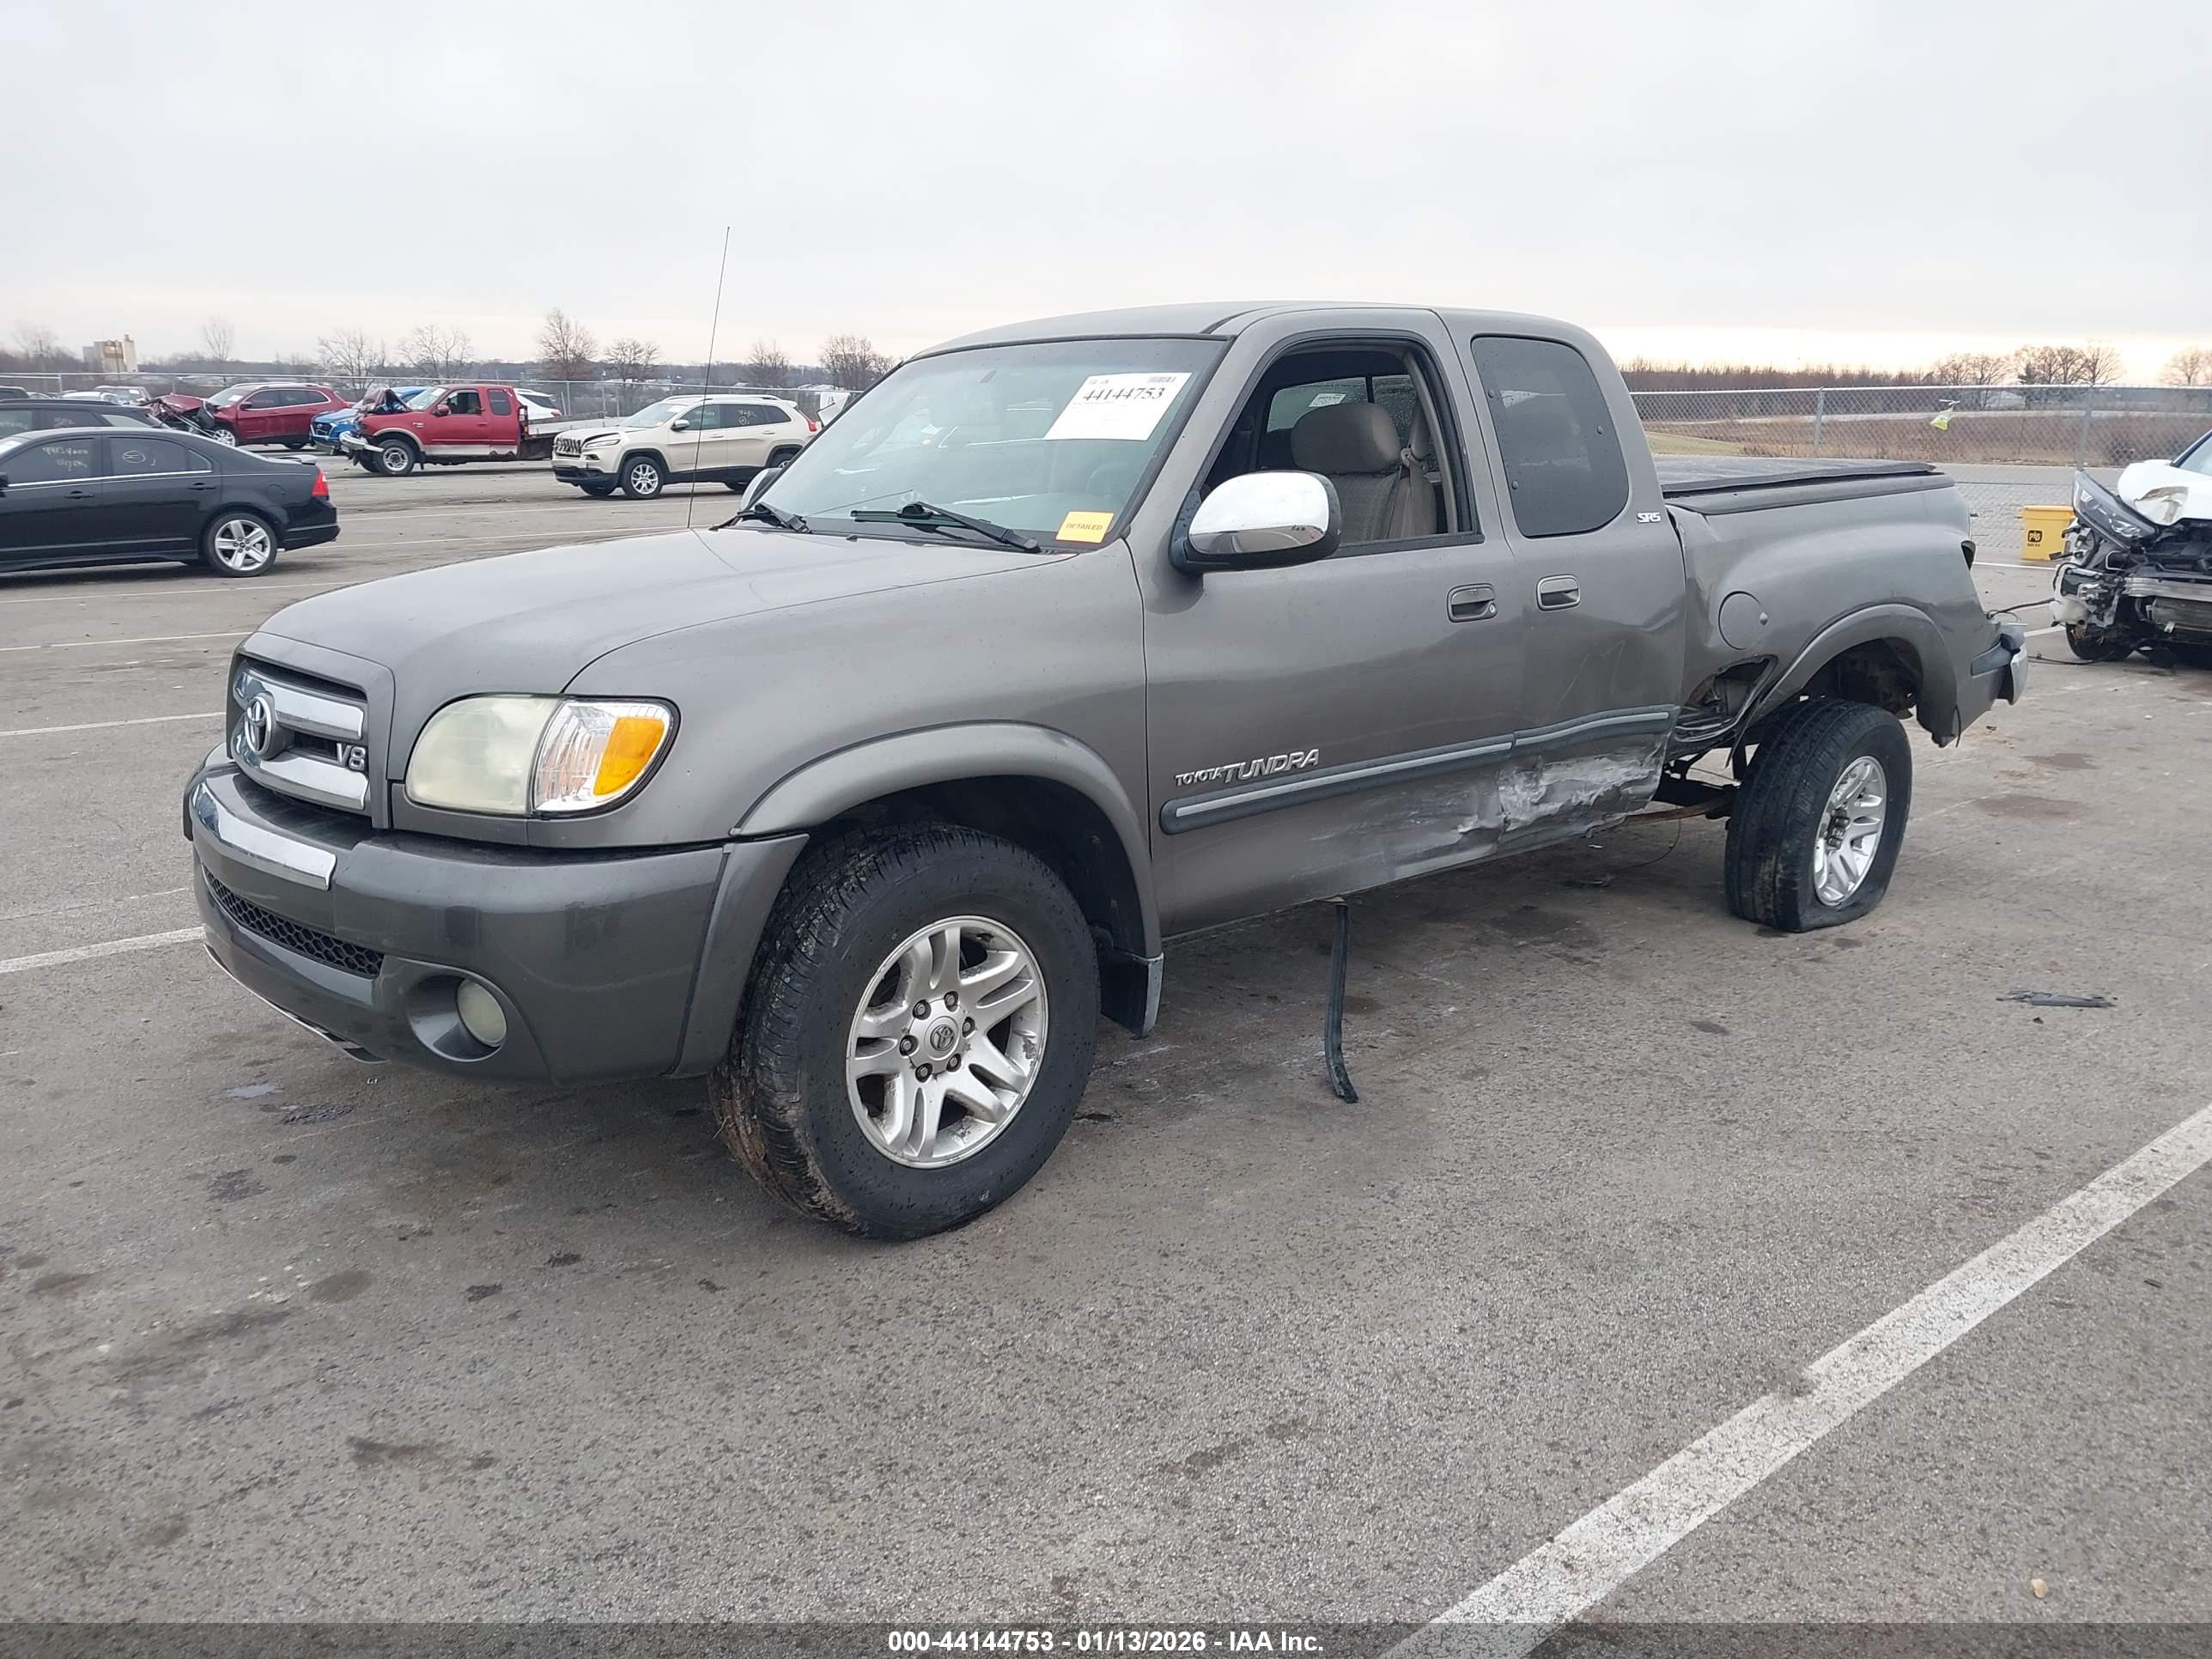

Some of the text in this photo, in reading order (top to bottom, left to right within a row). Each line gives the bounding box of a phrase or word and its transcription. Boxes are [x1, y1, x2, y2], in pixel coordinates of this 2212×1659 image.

[1083, 387, 1165, 401] 44144753
[1637, 512, 1662, 523] SR5
[1066, 522, 1103, 531] DETAILED
[336, 742, 367, 771] V8
[1175, 748, 1320, 787] TOYOTA TUNDRA
